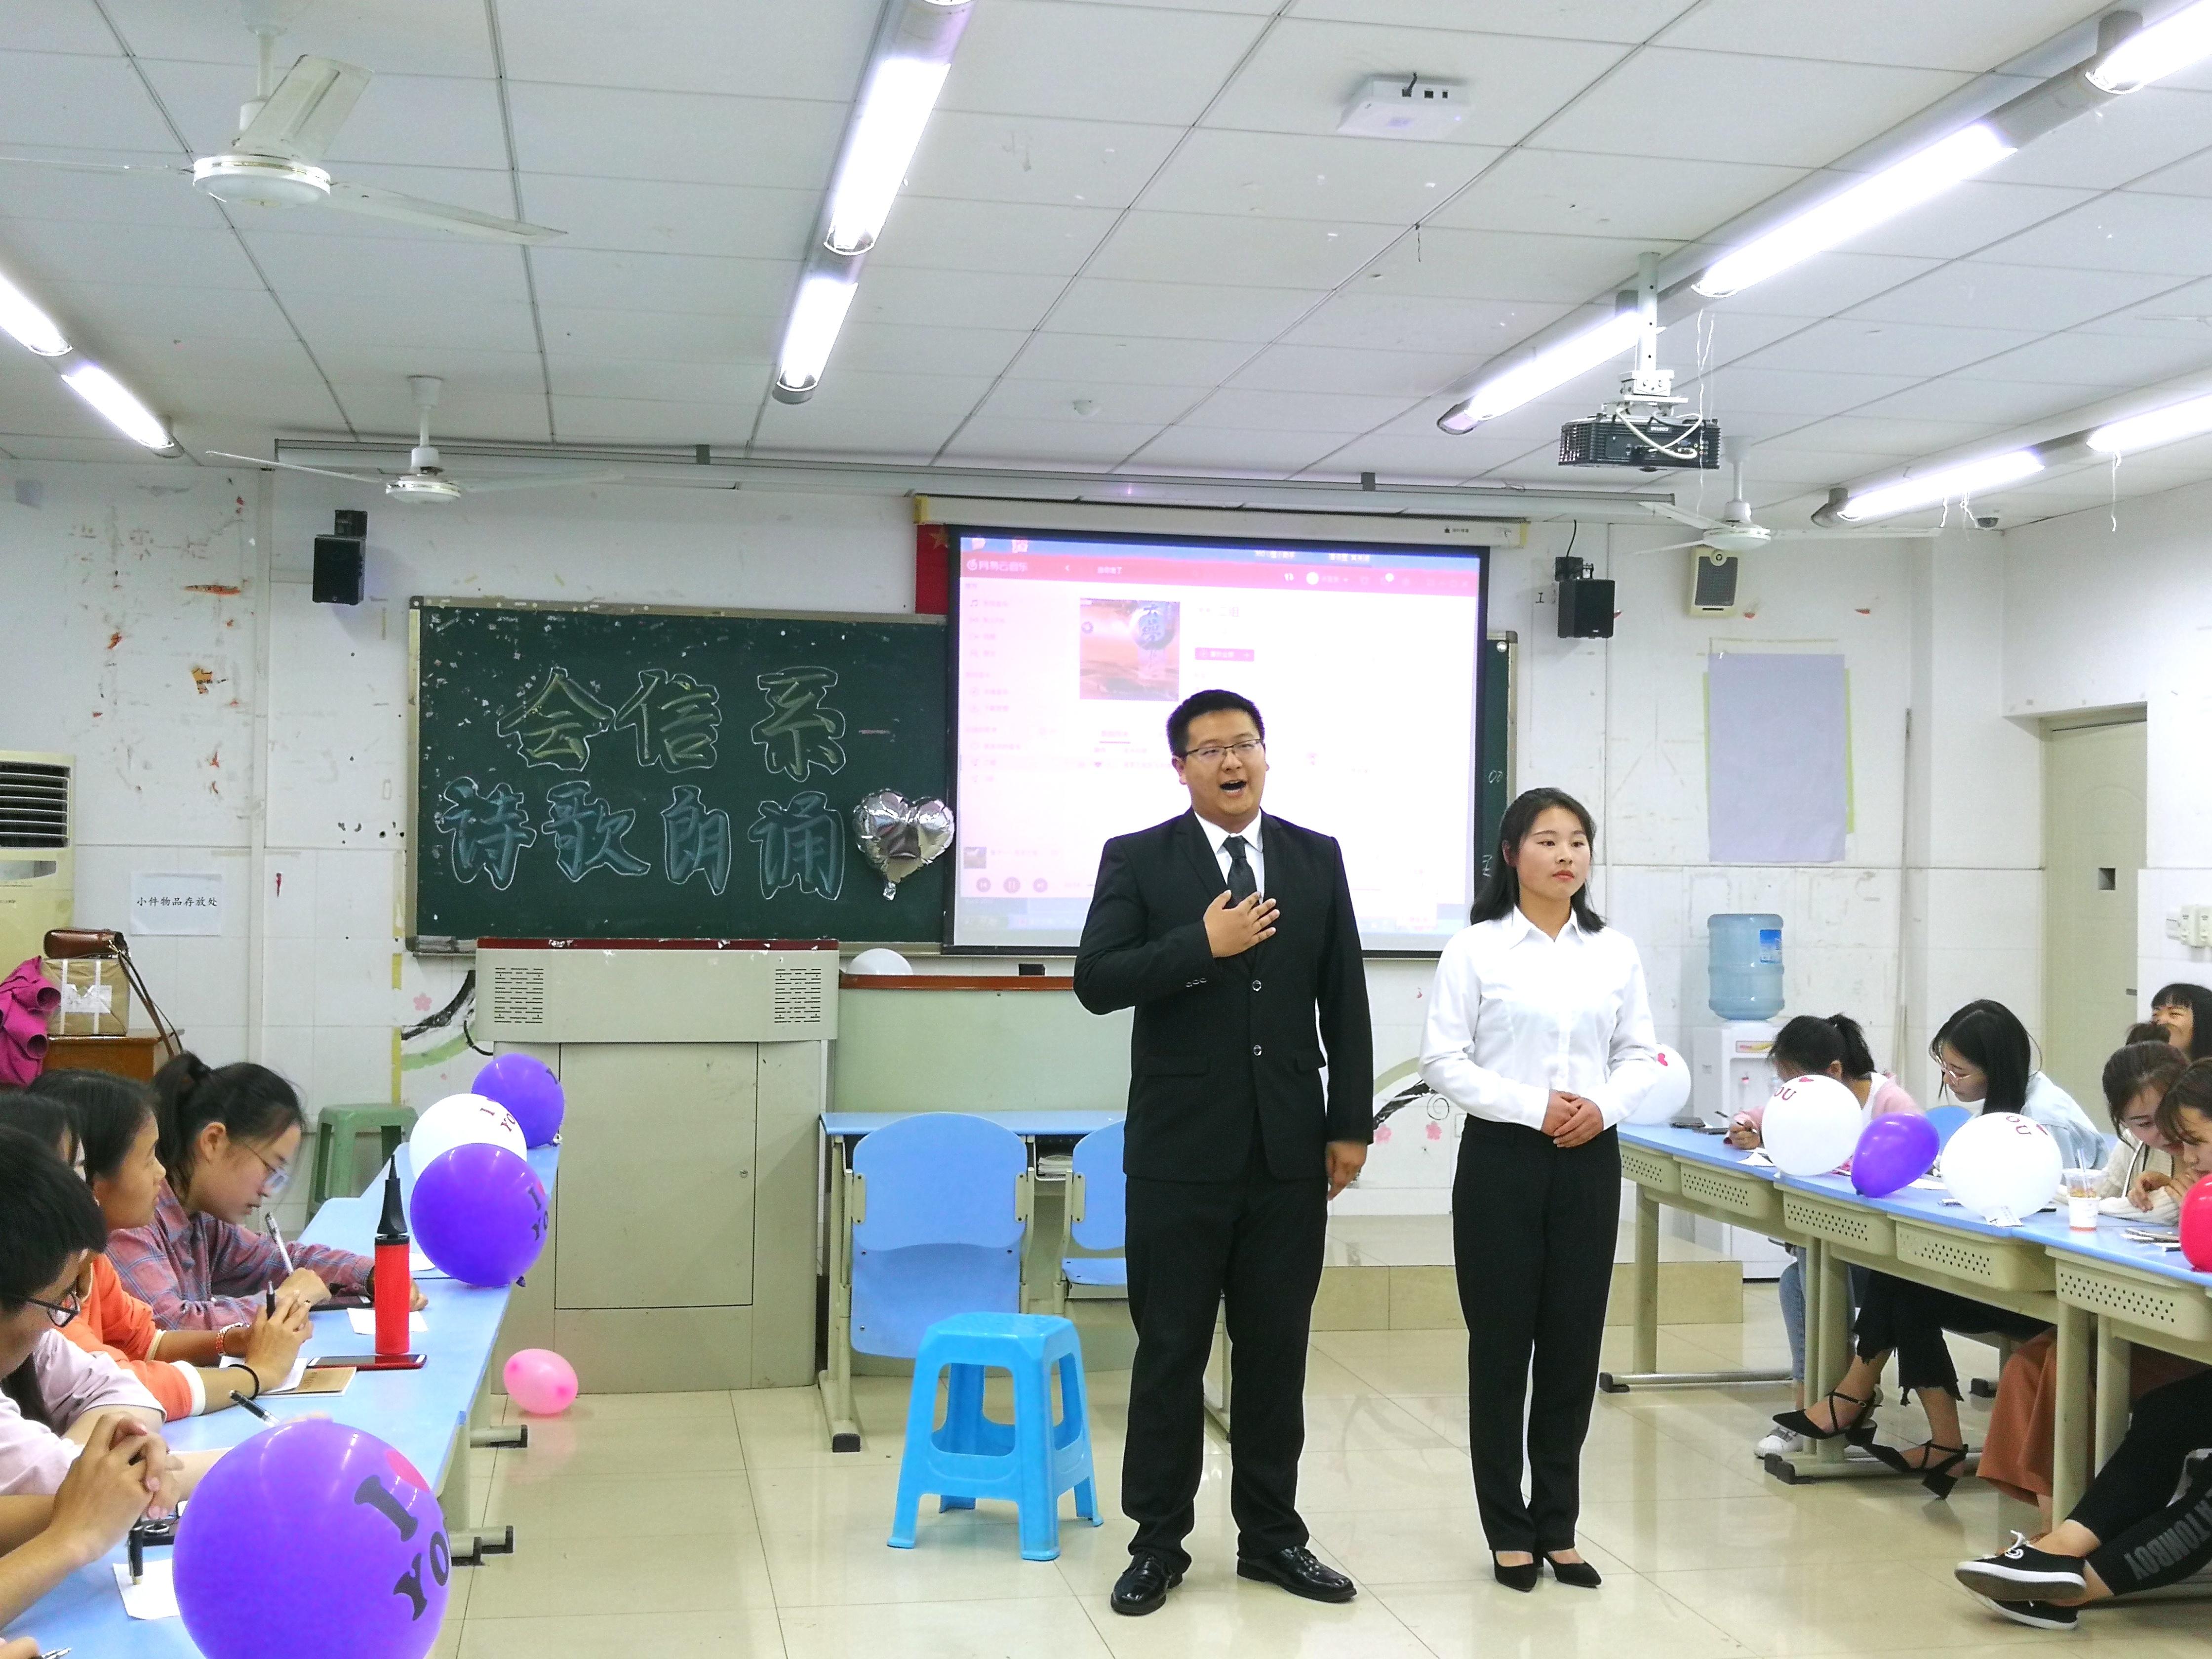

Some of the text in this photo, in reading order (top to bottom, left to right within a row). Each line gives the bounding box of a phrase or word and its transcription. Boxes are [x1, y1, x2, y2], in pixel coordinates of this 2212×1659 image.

[497, 665, 846, 782] 会信系
[437, 776, 845, 901] 诗歌朗诵
[136, 896, 218, 907] 小件物品存放处
[354, 1474, 419, 1542] I
